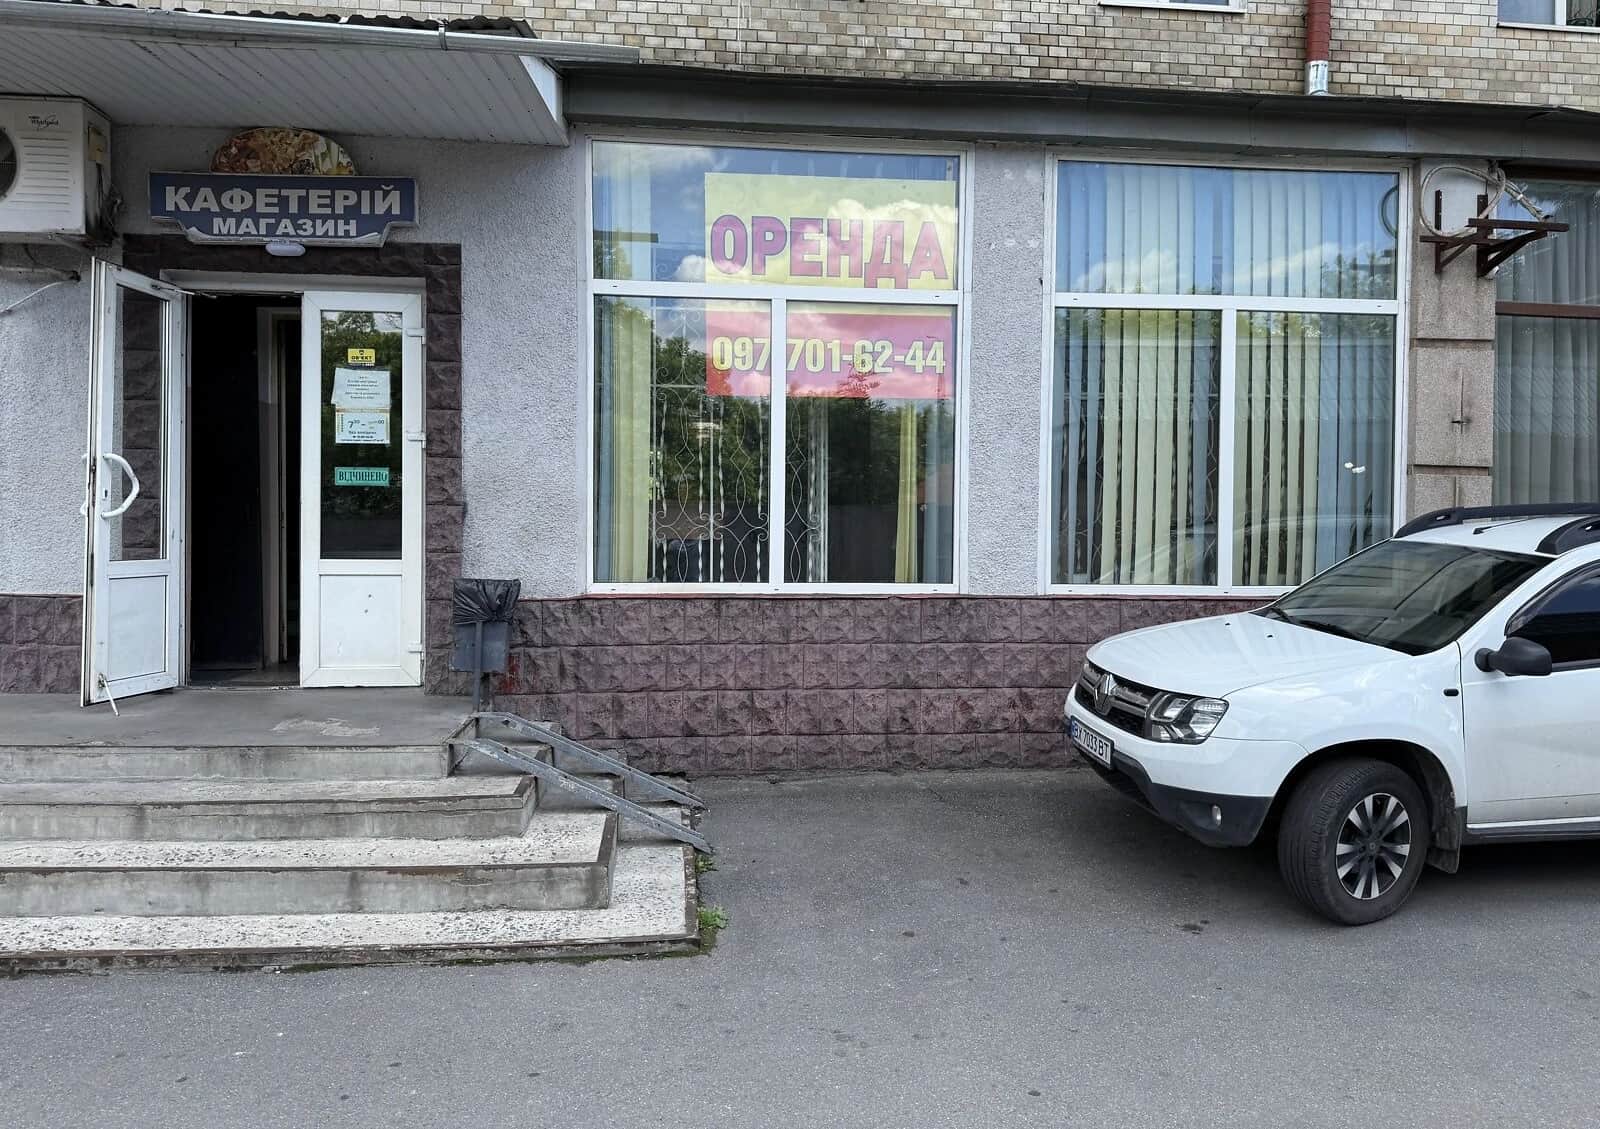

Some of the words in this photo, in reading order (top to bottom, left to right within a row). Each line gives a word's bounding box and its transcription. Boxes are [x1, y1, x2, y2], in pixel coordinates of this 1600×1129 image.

[165, 184, 401, 216] КАФЕТЕРІЙ
[212, 217, 358, 237] МАГАЗИН
[710, 213, 950, 290] ОРЕНДА
[712, 335, 771, 373] 097
[786, 337, 946, 375] 701-62-44
[339, 471, 388, 482] ВІДЧИНЕНО
